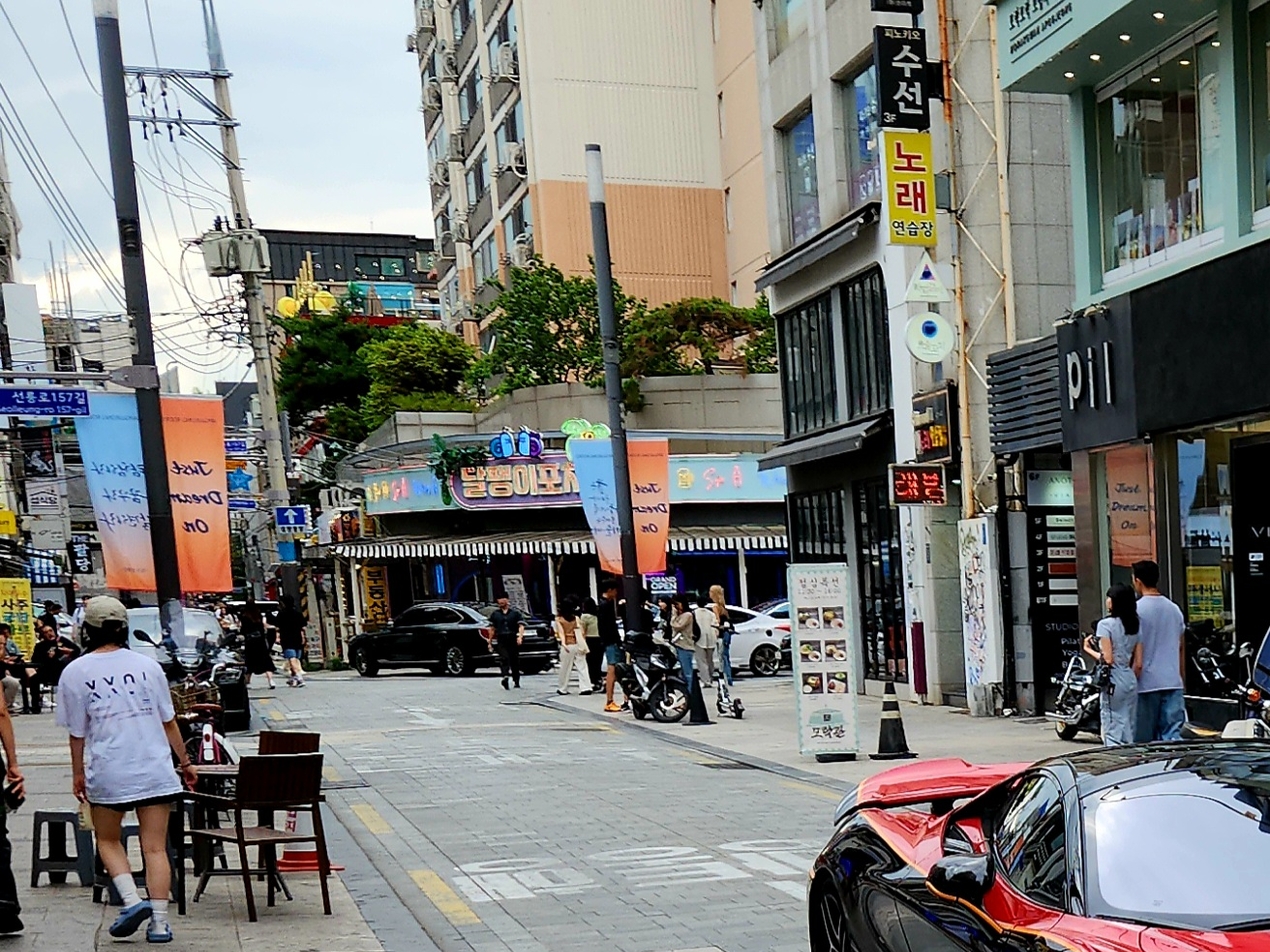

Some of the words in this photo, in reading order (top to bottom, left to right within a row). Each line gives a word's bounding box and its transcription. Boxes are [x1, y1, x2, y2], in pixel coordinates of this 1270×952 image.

[884, 28, 921, 40] 피노키오
[891, 44, 924, 115] 수선
[883, 112, 897, 123] 3F
[893, 142, 928, 215] 노래
[891, 220, 934, 238] 연습장
[1066, 341, 1114, 412] pil
[12, 391, 86, 405] 선릉로157길
[1, 598, 29, 610] 사주
